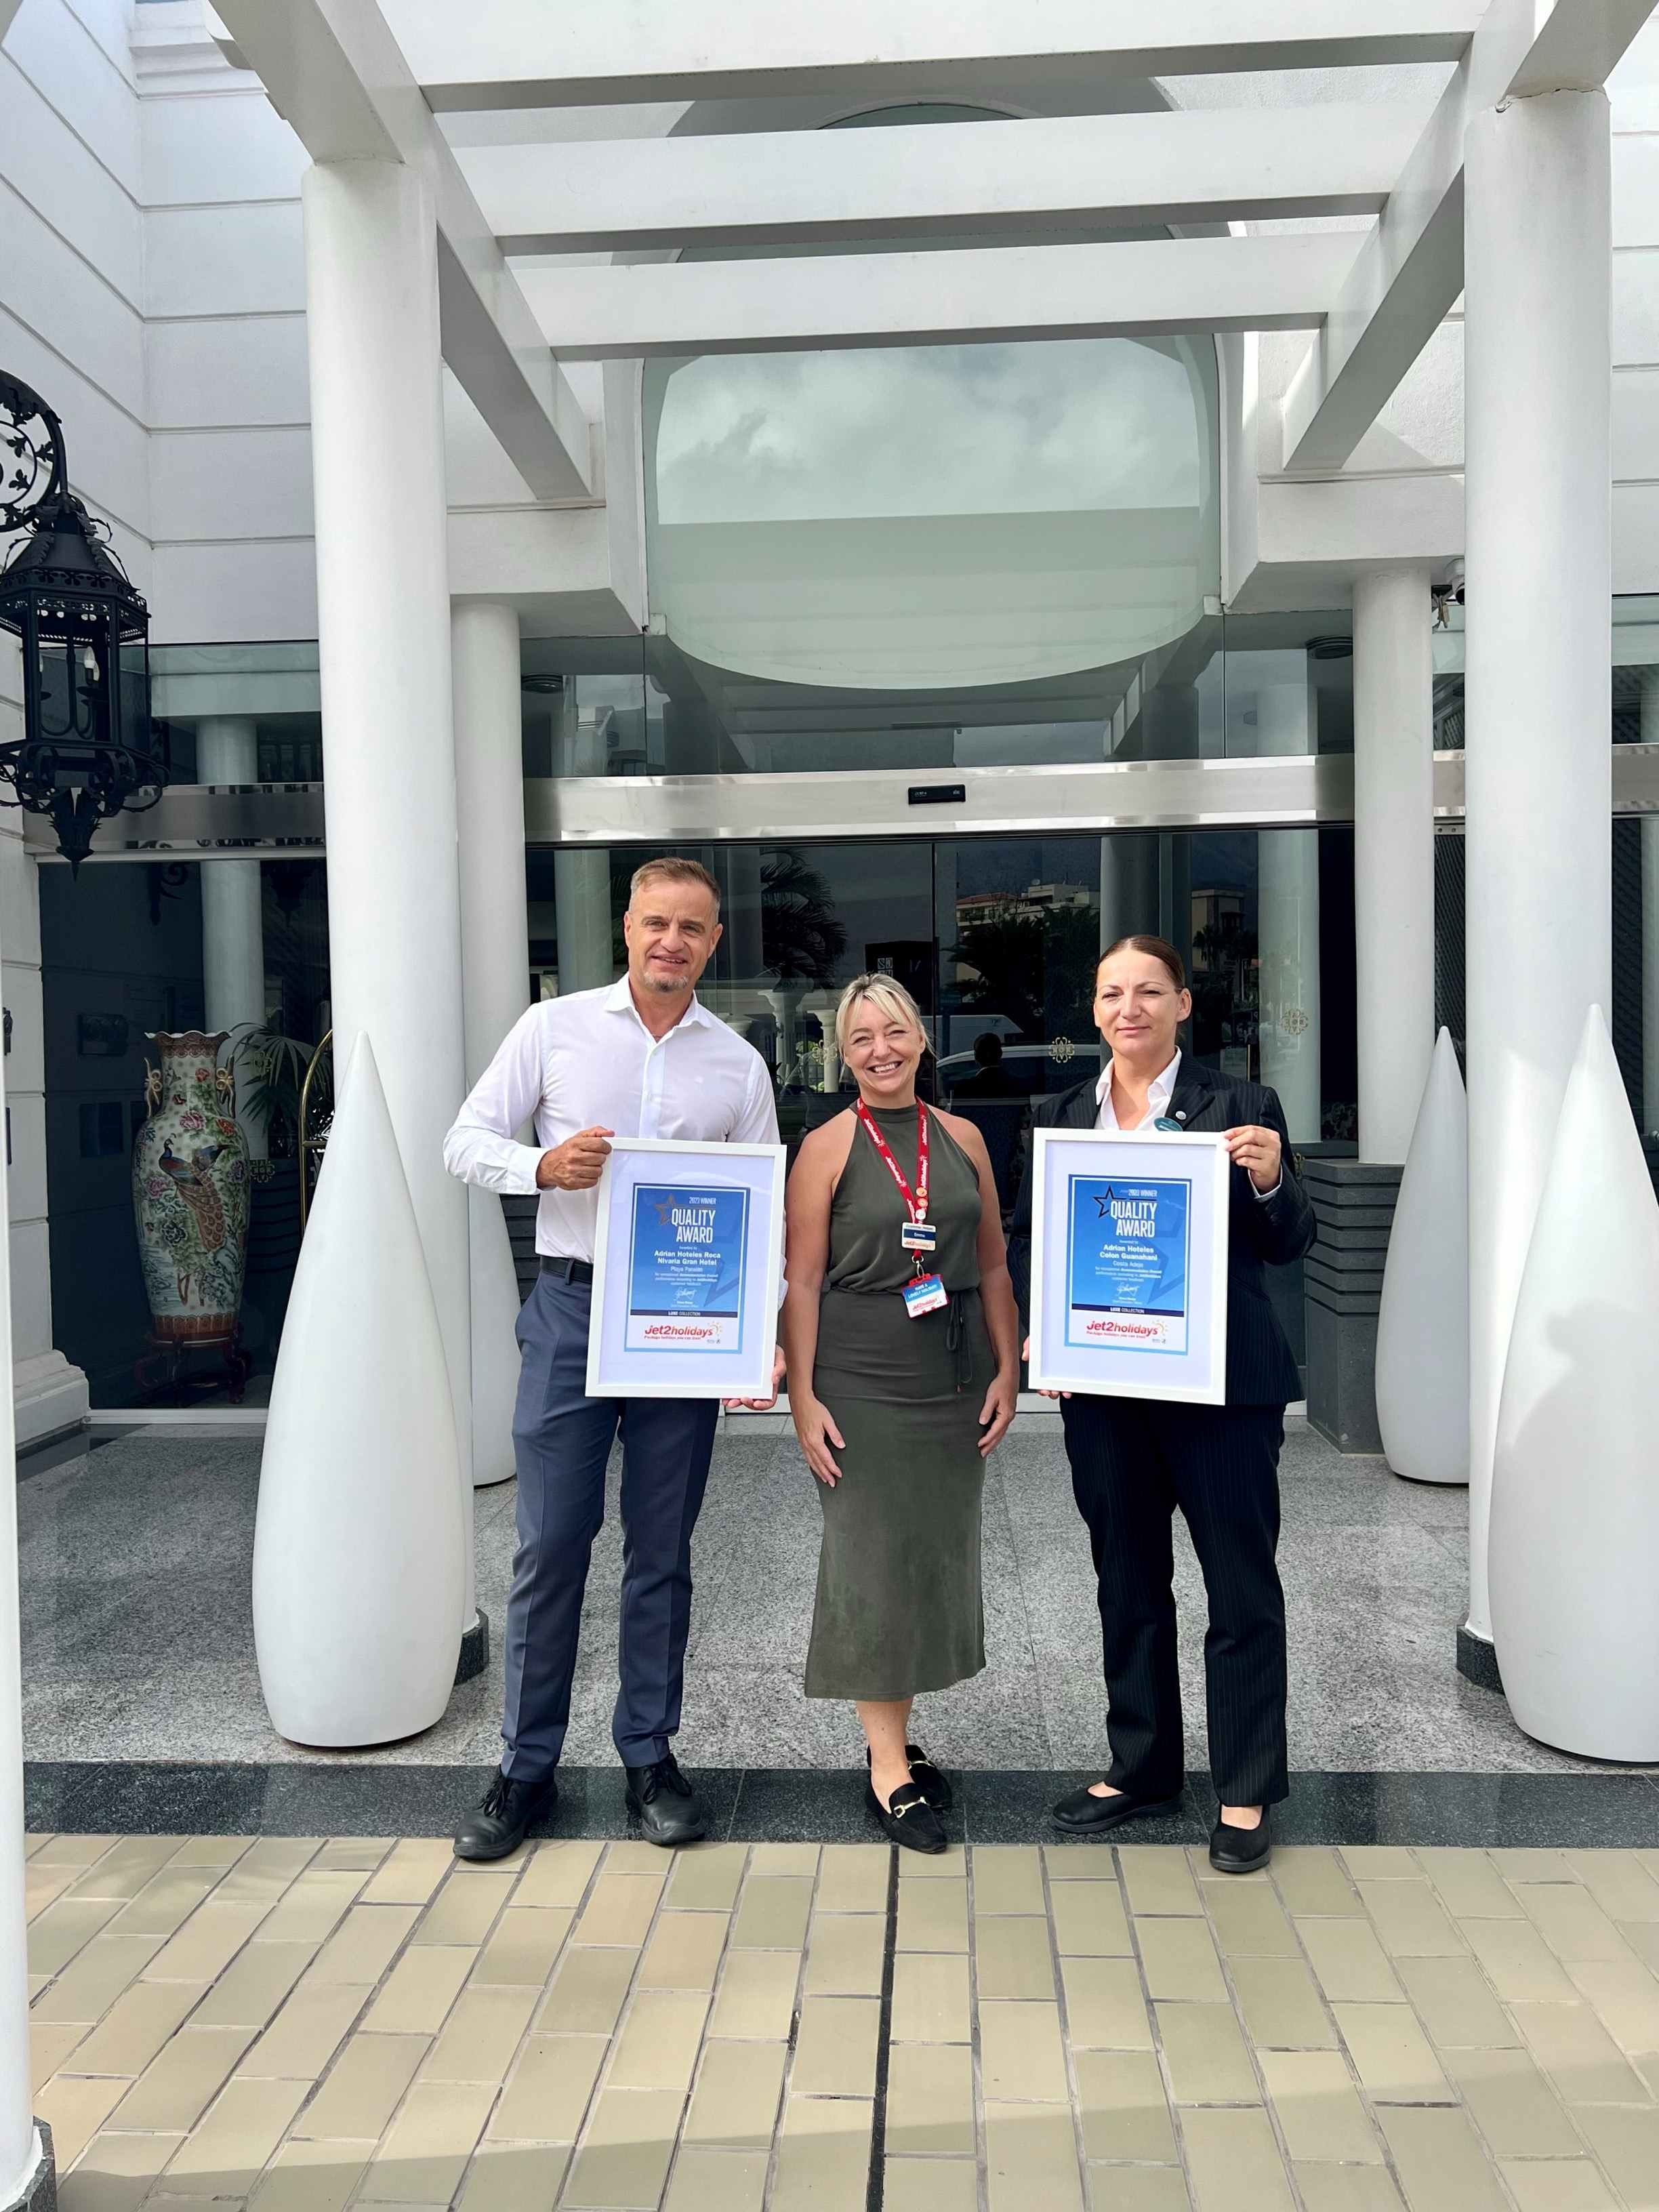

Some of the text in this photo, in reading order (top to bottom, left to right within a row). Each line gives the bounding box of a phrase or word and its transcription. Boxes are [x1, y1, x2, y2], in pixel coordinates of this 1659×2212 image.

[700, 1197, 716, 1205] WINNER
[672, 1208, 716, 1227] QUALITY
[1110, 1201, 1158, 1220] QUALITY
[676, 1227, 713, 1244] AWARD
[1115, 1219, 1155, 1237] AWARD
[1121, 1252, 1158, 1261] Guanahani
[1127, 1245, 1153, 1253] Hoteles
[644, 1325, 713, 1338] Jet2holidays
[1086, 1321, 1158, 1336] Jet2holidays
